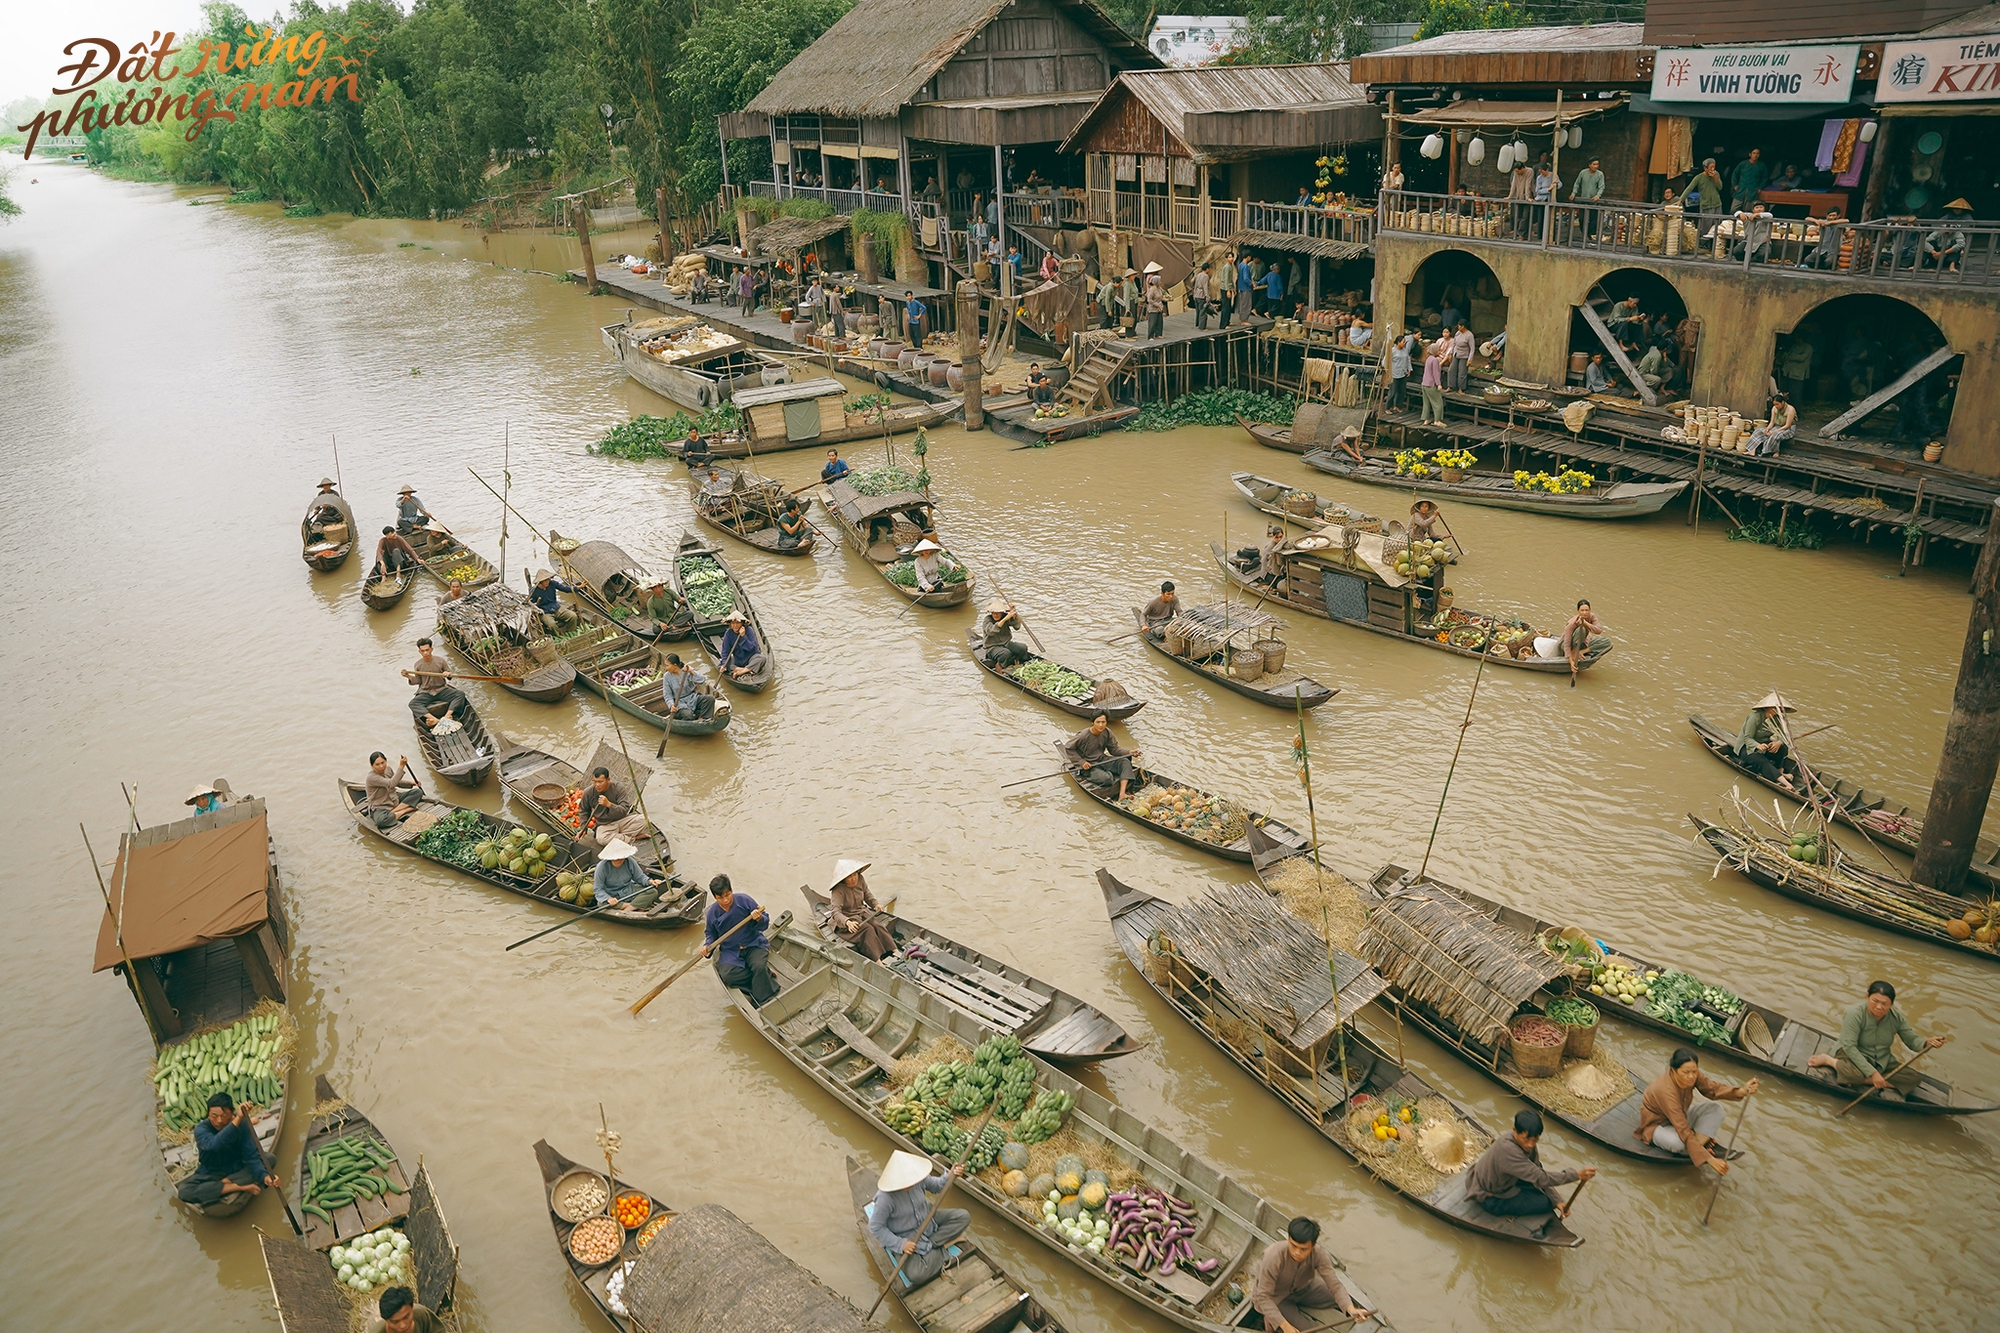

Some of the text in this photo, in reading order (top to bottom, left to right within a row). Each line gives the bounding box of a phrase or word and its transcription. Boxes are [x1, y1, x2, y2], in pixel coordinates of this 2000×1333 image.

[1960, 40, 2000, 61] TIỆM
[1665, 57, 1692, 87] 祥
[1699, 69, 1802, 94] VĨNH TƯỜNG
[1811, 54, 1842, 86] 永
